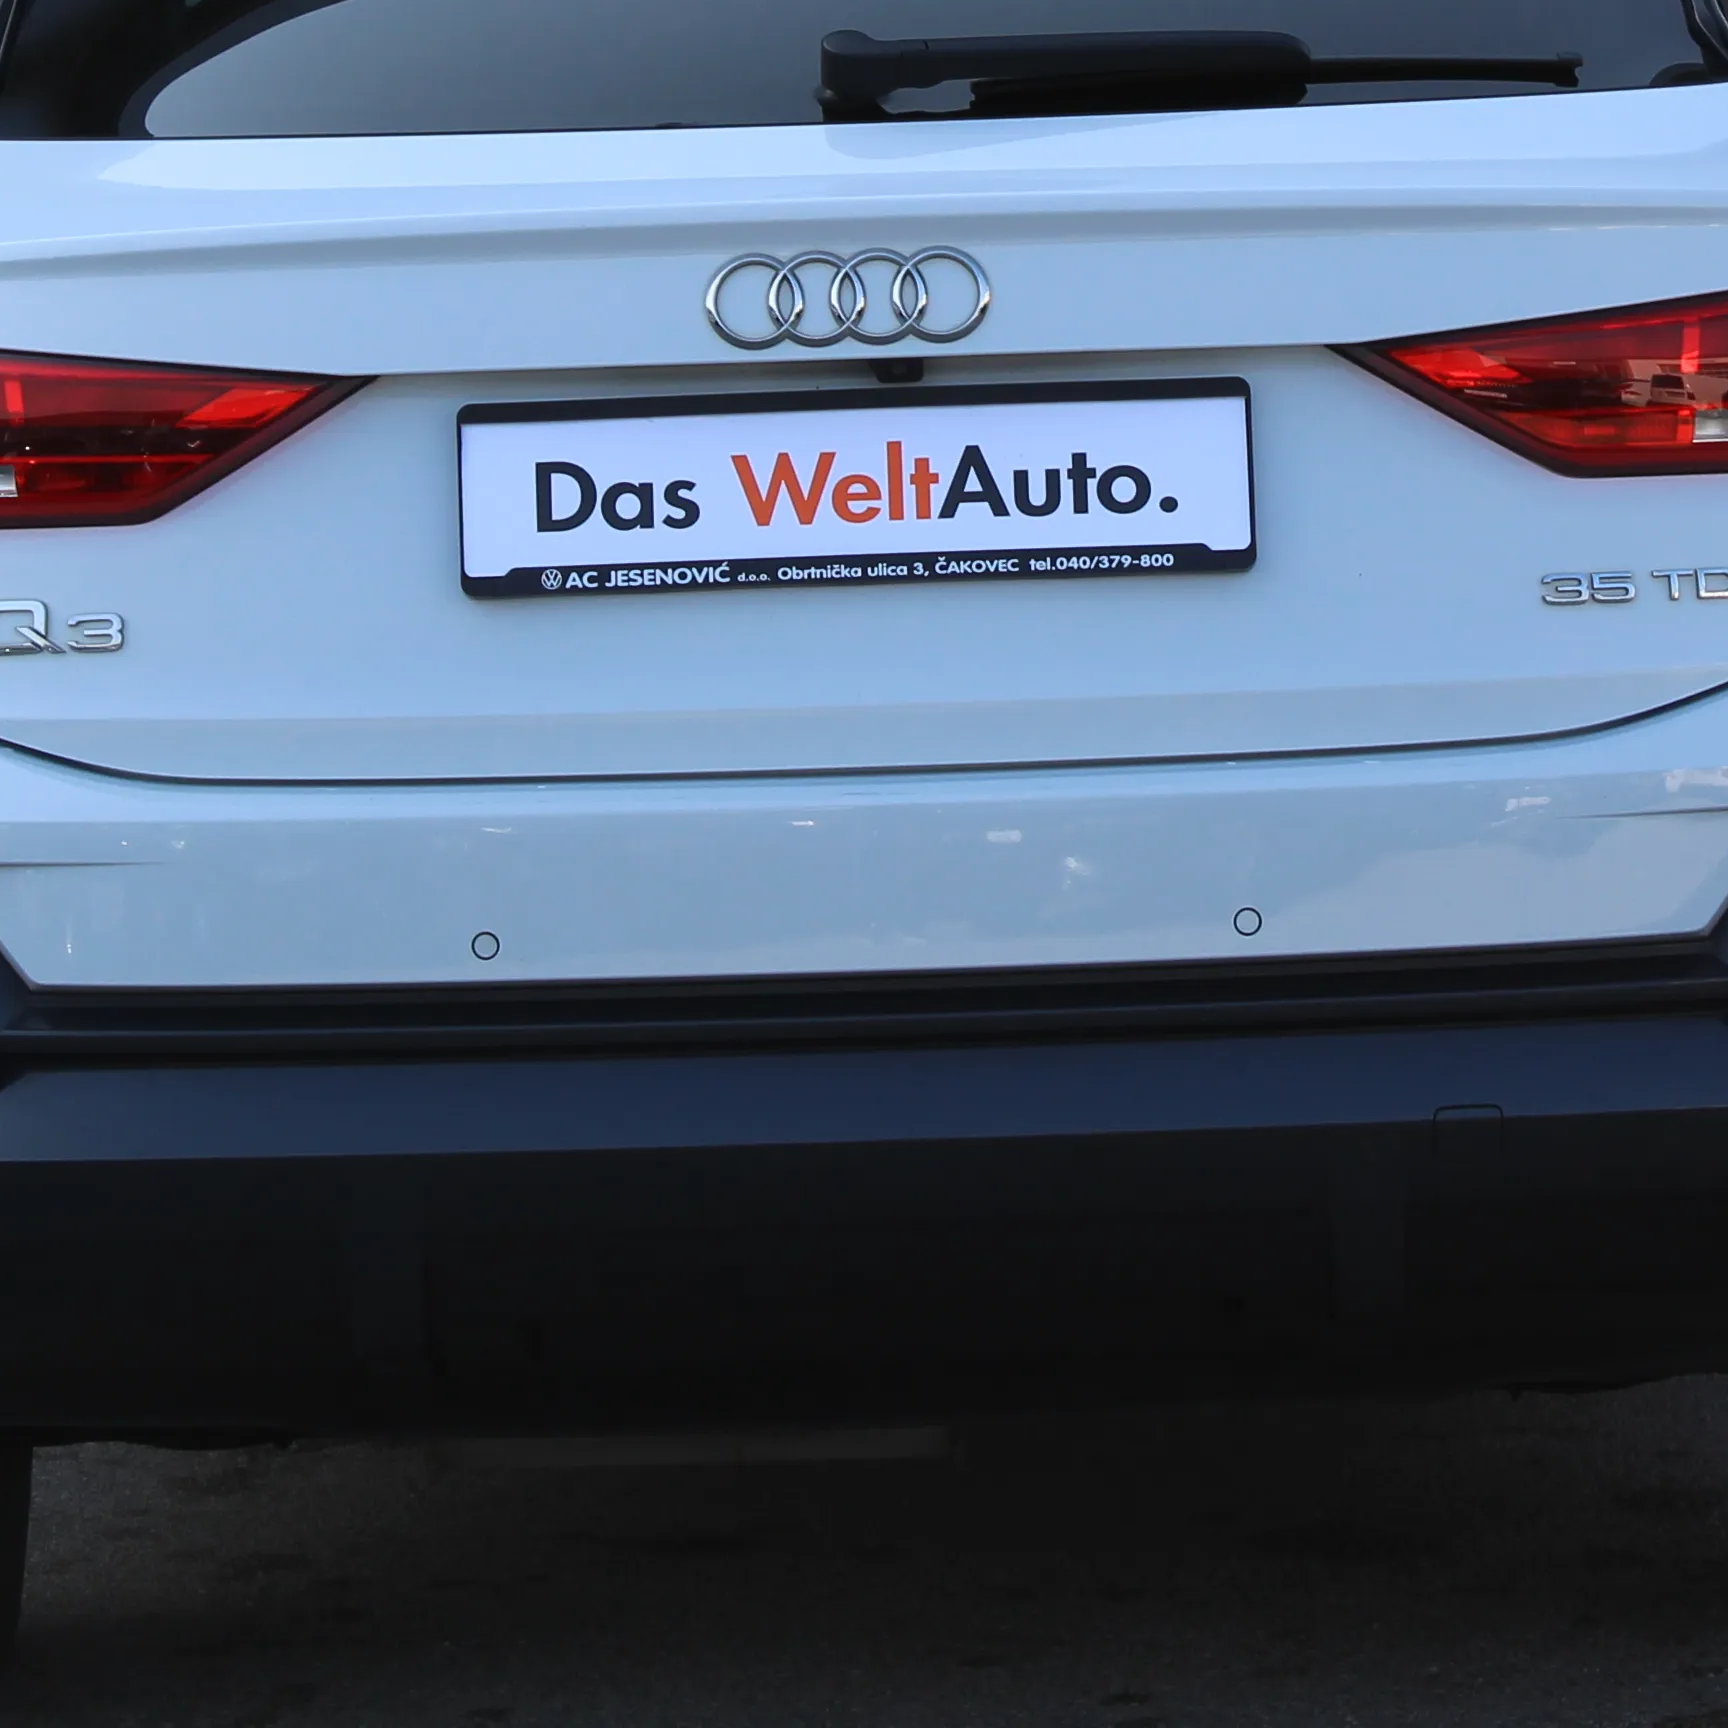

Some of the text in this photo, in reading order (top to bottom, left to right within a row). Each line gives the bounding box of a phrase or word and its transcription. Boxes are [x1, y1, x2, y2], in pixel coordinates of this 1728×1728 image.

[534, 440, 1179, 533] Das WeltAuto.
[565, 571, 599, 589] AC
[605, 561, 730, 587] JESENOVIĆ
[737, 572, 771, 582] d.o.o.
[777, 564, 862, 580] Obrtnička
[867, 562, 908, 577] ulica
[913, 562, 929, 577] 3,
[934, 556, 1020, 574] ČAKOVEC
[1540, 571, 1636, 606] 35
